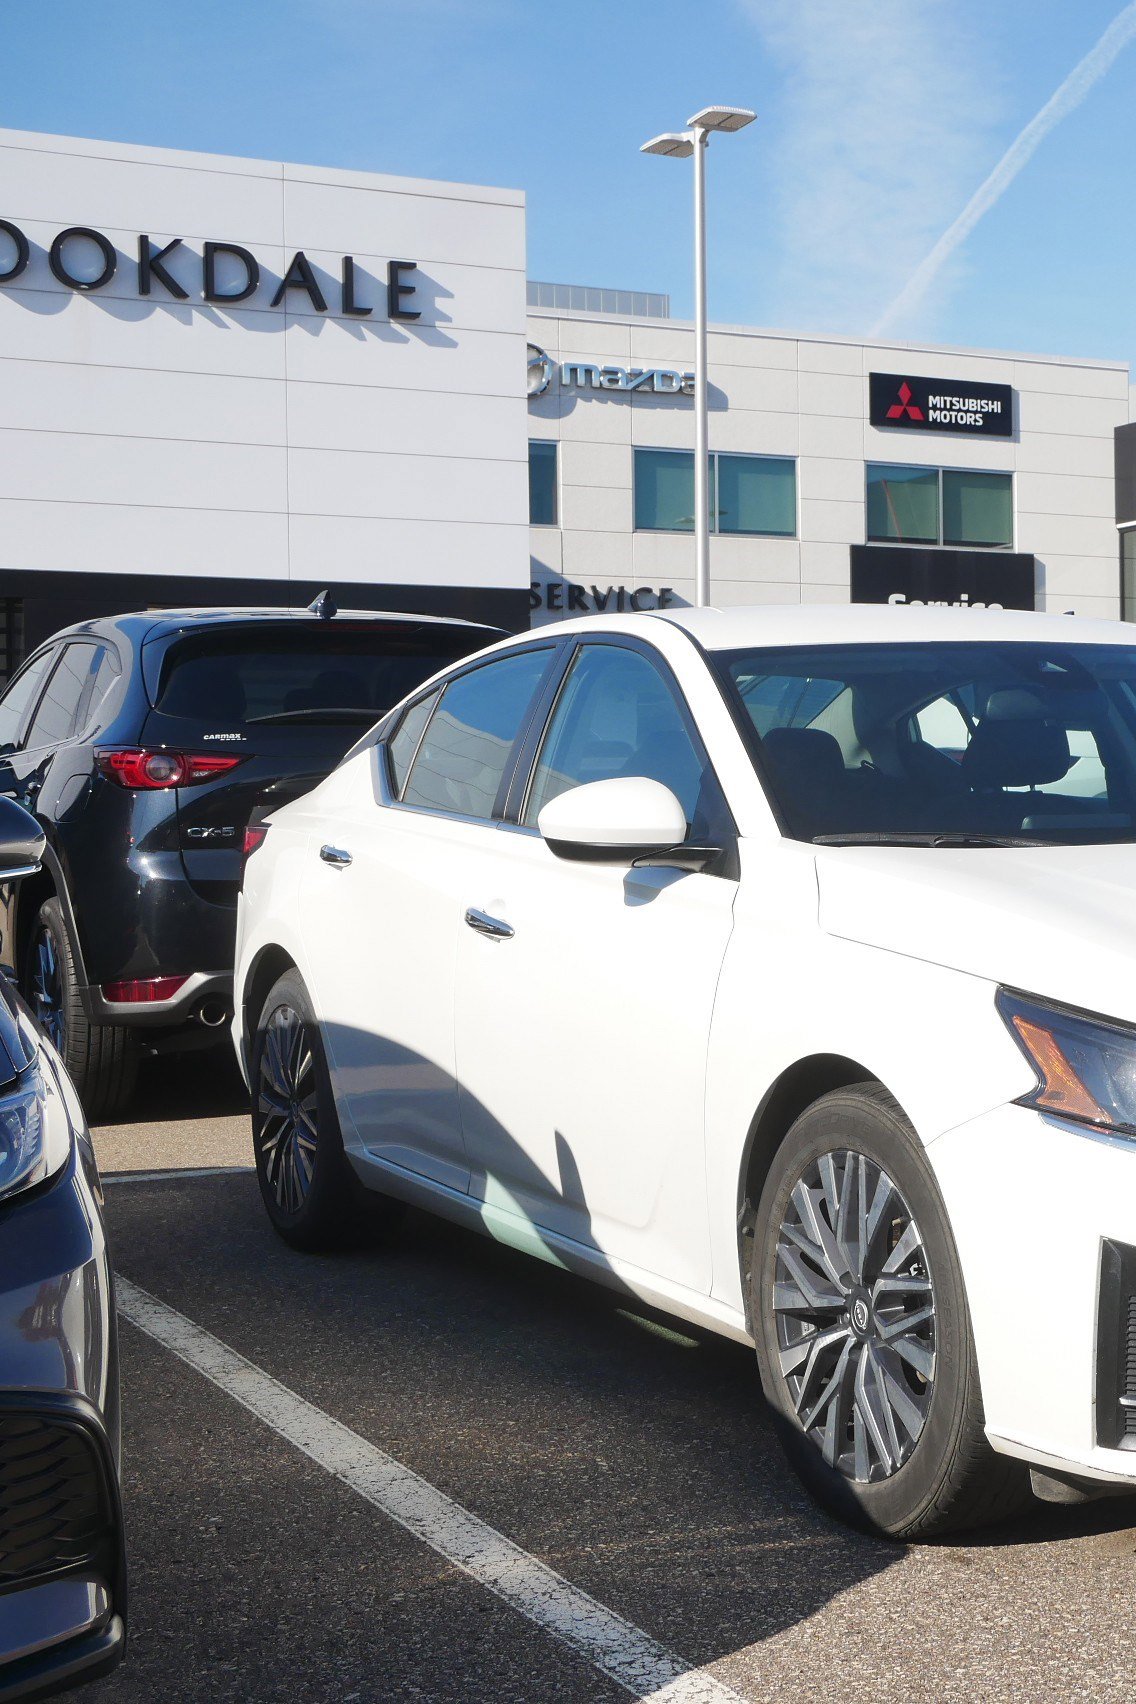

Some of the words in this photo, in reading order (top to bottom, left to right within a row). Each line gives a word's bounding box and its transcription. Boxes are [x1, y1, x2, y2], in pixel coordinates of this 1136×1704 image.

[928, 395, 1002, 414] MITSUBISHI
[928, 409, 984, 426] MOTORS
[187, 826, 235, 838] CX-5
